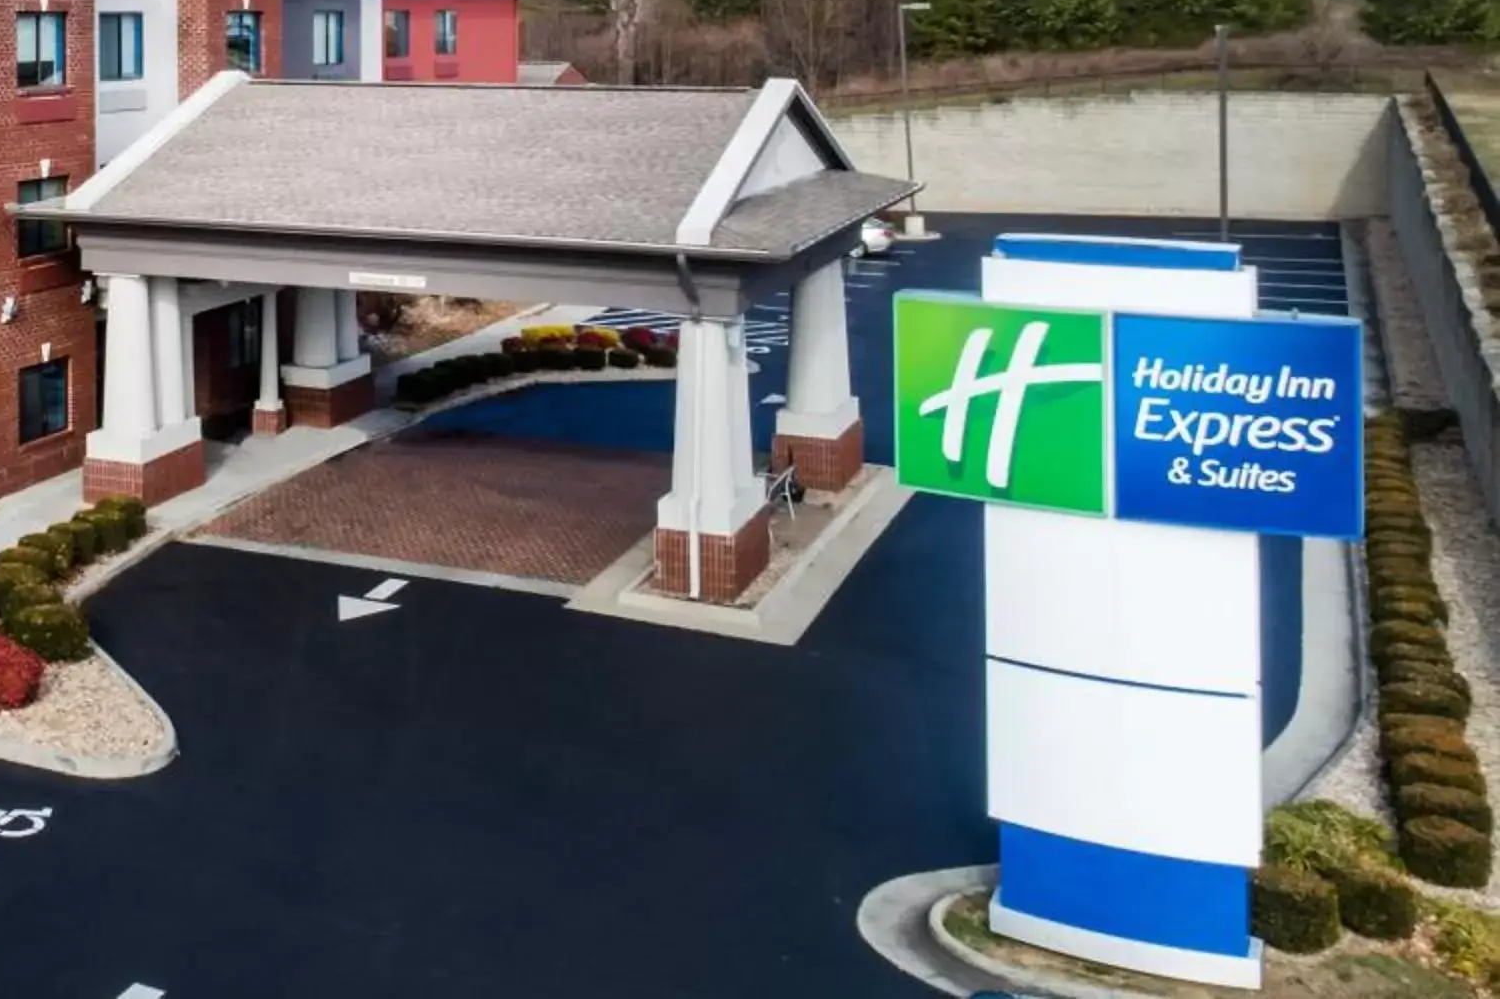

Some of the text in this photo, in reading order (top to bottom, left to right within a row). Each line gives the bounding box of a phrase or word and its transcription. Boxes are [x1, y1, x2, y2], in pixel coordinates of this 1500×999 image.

[919, 320, 1102, 489] H
[1131, 356, 1336, 404] Holiday Inn
[1134, 397, 1336, 456] Express
[1167, 456, 1297, 493] & Suites
